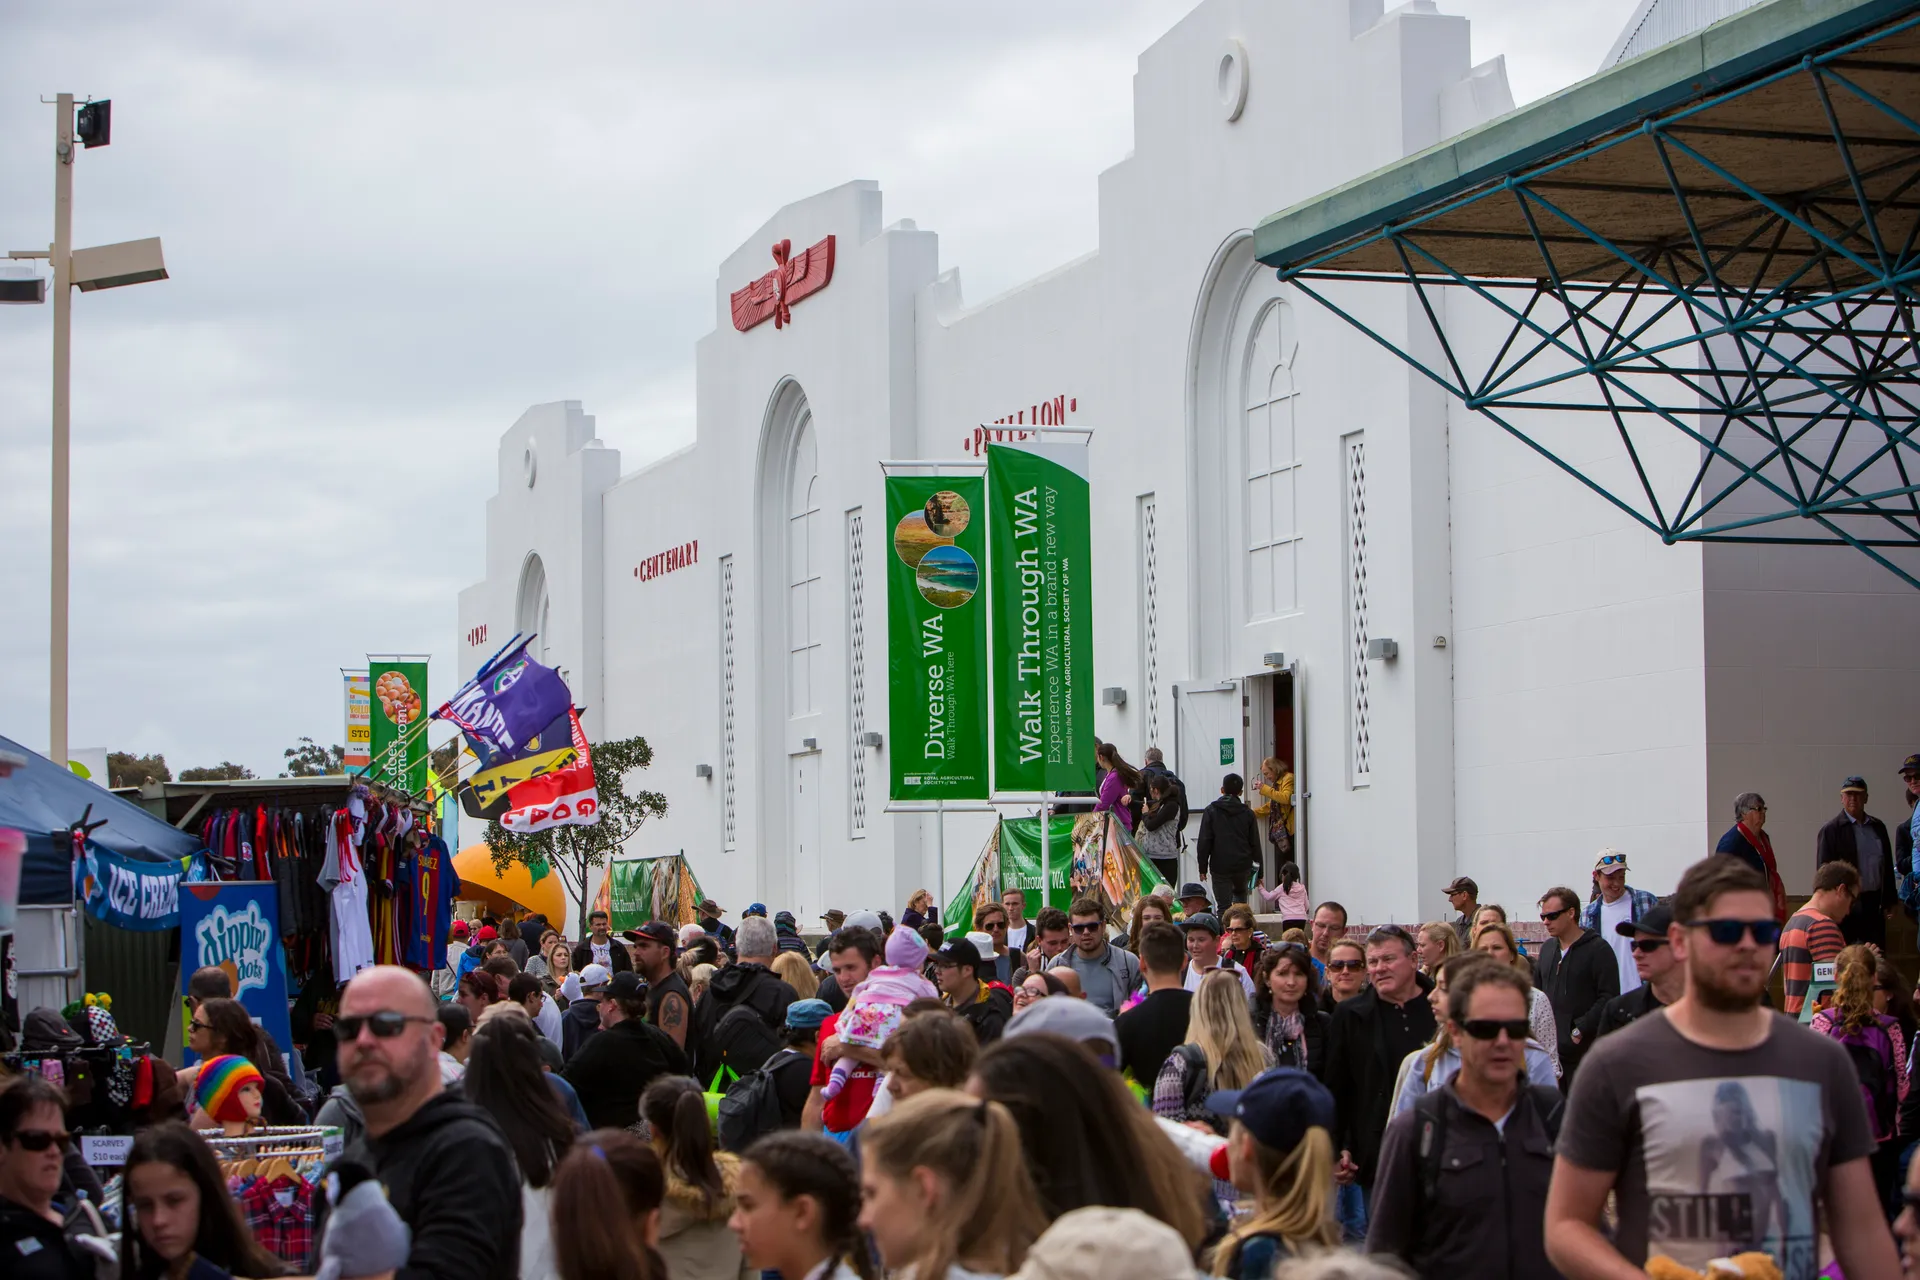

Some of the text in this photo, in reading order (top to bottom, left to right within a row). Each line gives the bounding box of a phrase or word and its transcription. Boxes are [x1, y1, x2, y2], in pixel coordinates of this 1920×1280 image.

[973, 394, 1065, 457] PAVILION
[640, 539, 698, 583] CENTENARY
[1062, 557, 1069, 572] WA
[1062, 573, 1070, 585] OF
[1063, 587, 1071, 622] SOCIETY
[1014, 486, 1045, 765] Walk Through WA
[1044, 485, 1063, 764] Experience WA in a brand new way
[1063, 623, 1072, 687] AGRICULTURAL
[922, 613, 944, 759] Diverse WA
[1064, 688, 1072, 715] ROYAL
[946, 651, 957, 760] Walk Through WA here
[351, 729, 370, 738] STO
[385, 740, 398, 776] does
[398, 747, 408, 791] come
[503, 797, 597, 826] GOAL
[108, 863, 138, 916] ICE
[139, 872, 183, 919] CREAM
[422, 871, 431, 916] 9
[1018, 872, 1044, 895] Throug
[1052, 870, 1066, 889] WA
[202, 911, 266, 966] dippin'
[237, 958, 262, 980] dots
[1816, 967, 1834, 976] GEN
[92, 1139, 125, 1148] SCARVES
[93, 1151, 128, 1161] $10 each
